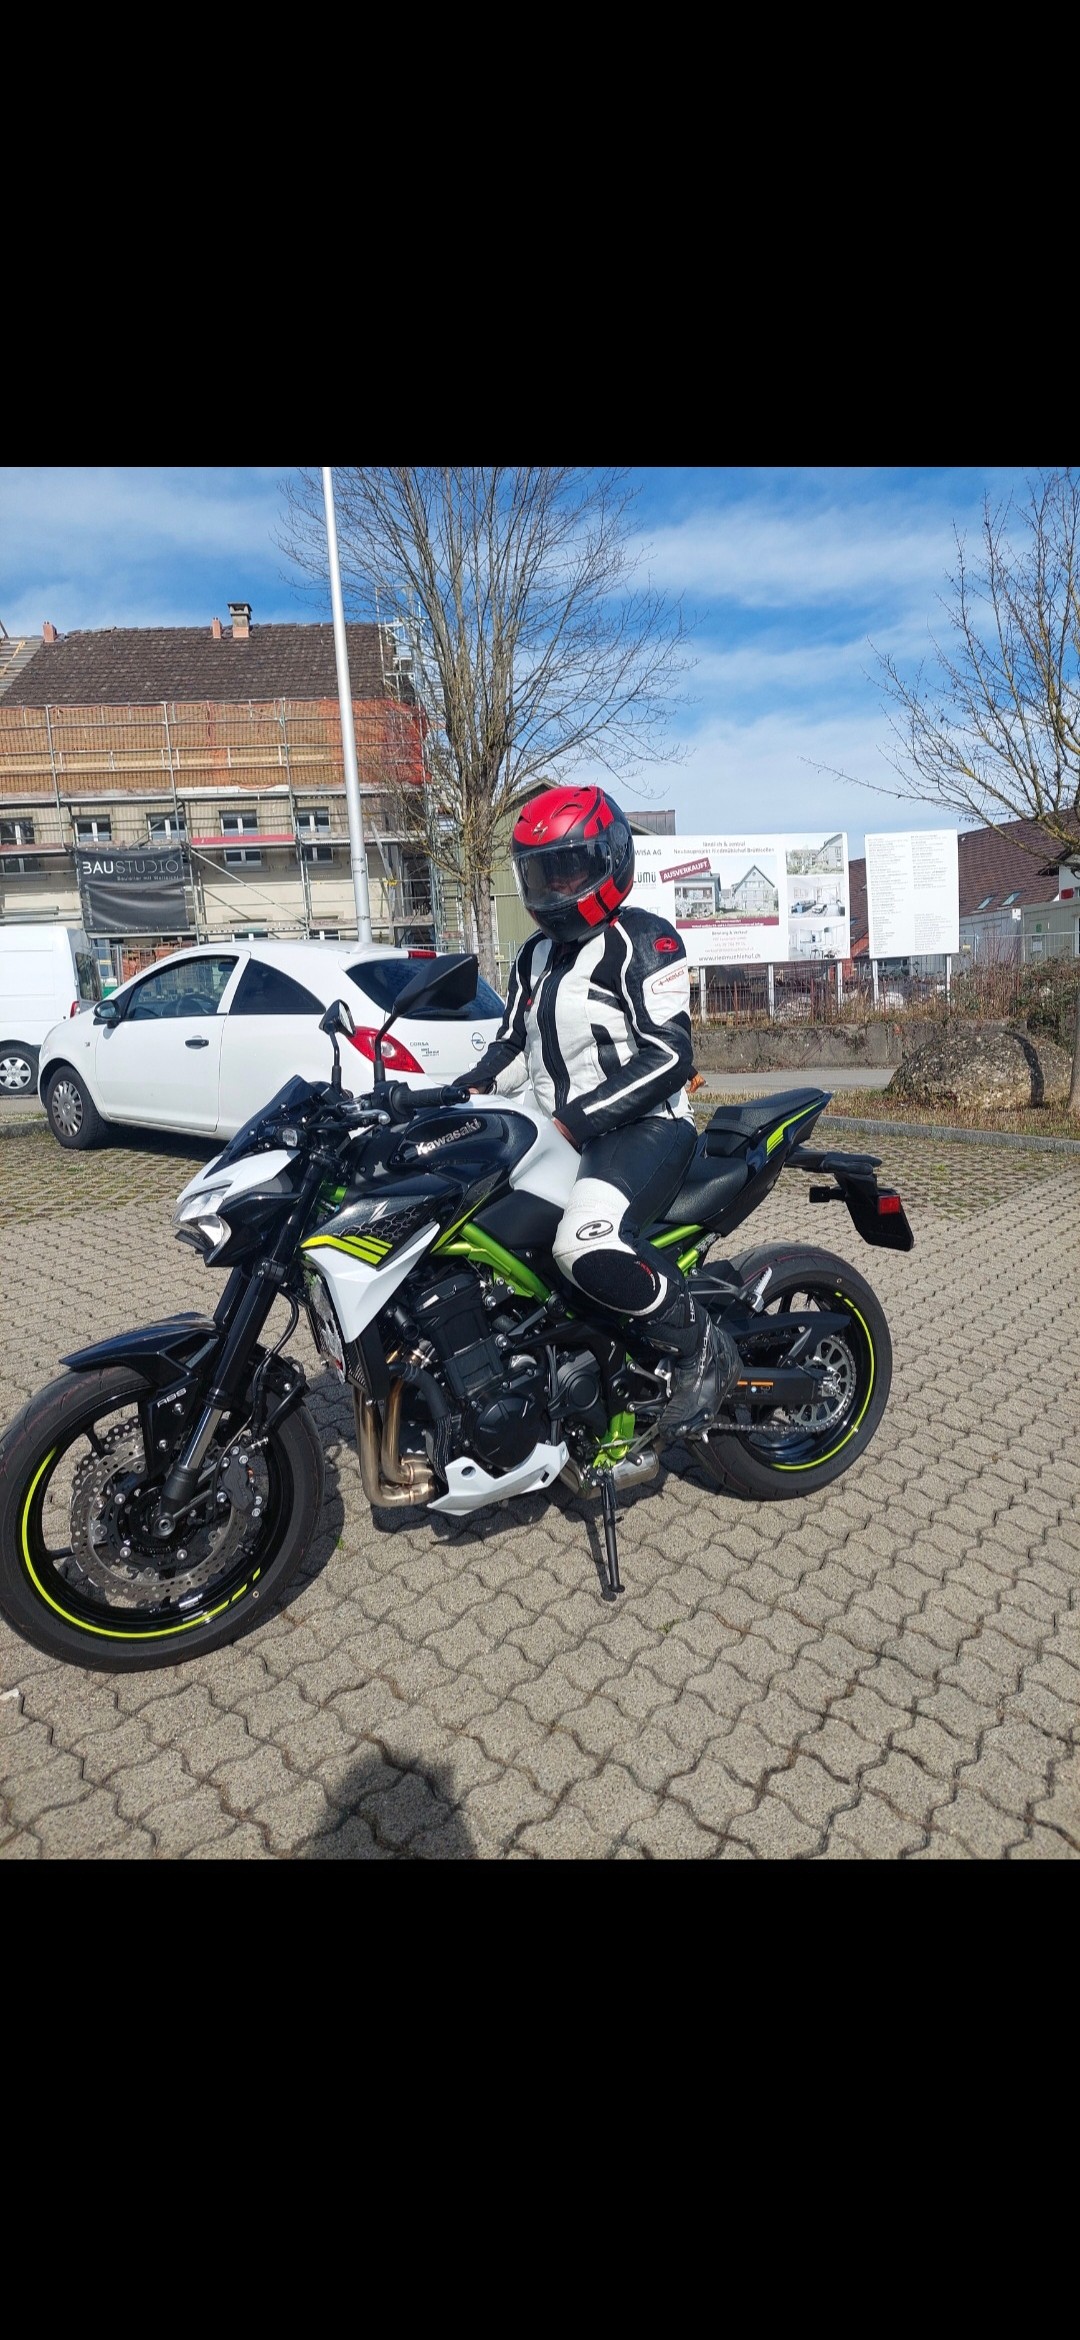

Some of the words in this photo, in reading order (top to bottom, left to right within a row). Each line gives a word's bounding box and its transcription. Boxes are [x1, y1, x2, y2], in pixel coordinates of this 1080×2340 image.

[663, 861, 708, 880] AUSVERKAUFT
[416, 1118, 481, 1156] Kawasaki
[156, 1387, 187, 1408] ABS
